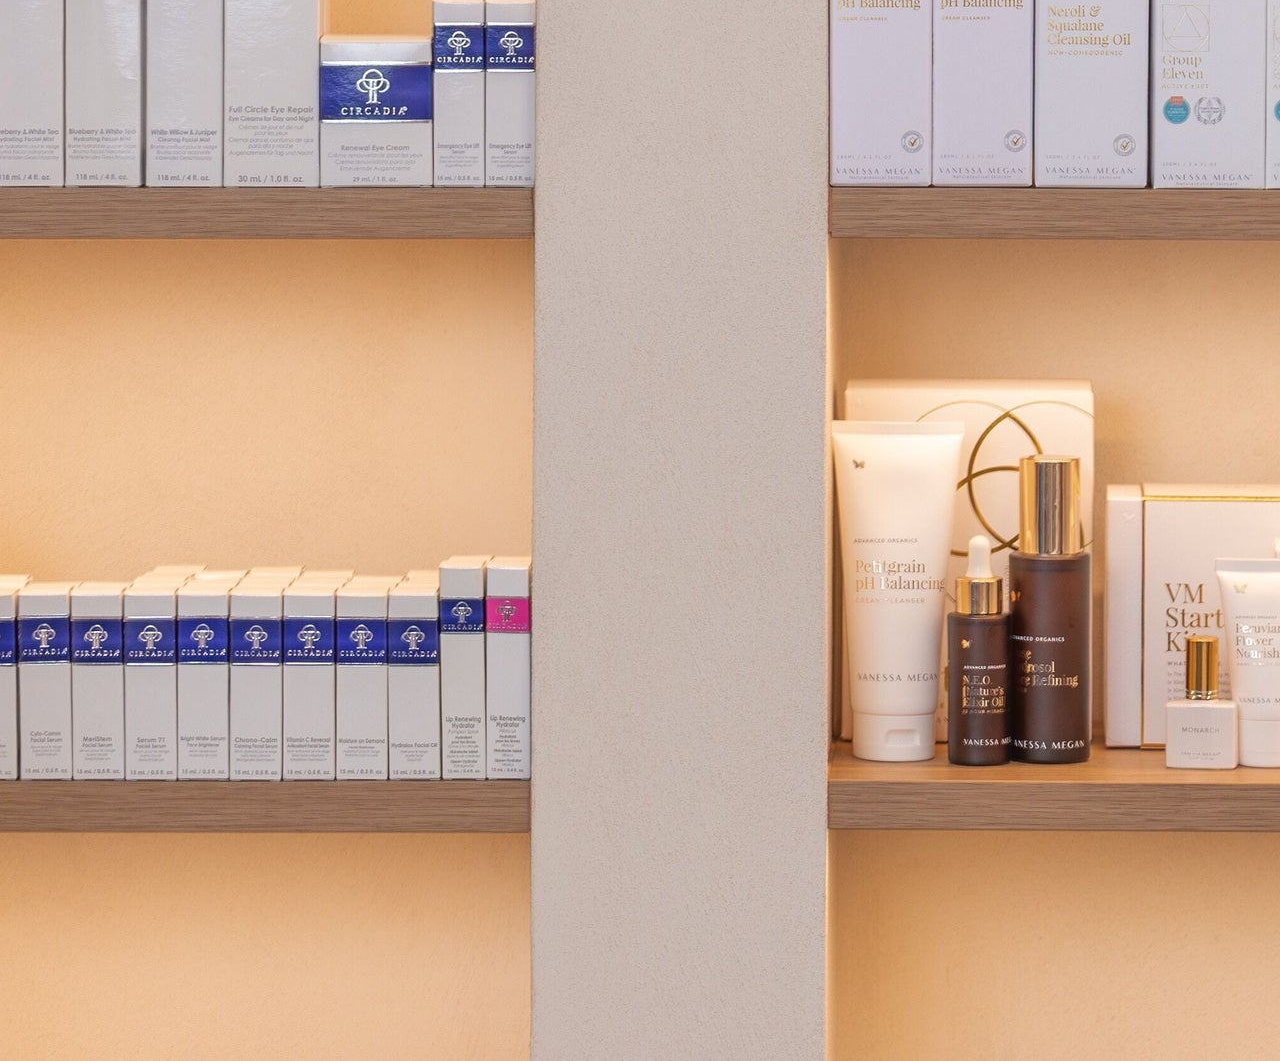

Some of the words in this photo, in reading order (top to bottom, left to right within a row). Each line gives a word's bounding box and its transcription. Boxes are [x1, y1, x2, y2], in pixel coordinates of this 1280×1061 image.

[1047, 4, 1086, 18] Neroli
[1089, 5, 1102, 17] &
[1047, 19, 1105, 34] Squalane
[1047, 33, 1109, 47] Cleansing
[1112, 33, 1131, 46] Oil
[1162, 54, 1202, 68] Group
[1162, 67, 1203, 80] Eleven
[228, 105, 244, 114] Full
[245, 105, 270, 114] Circle
[271, 106, 286, 115] Eye
[288, 105, 314, 115] Repair
[341, 144, 371, 152] Renewal
[371, 144, 386, 153] Eye
[855, 559, 926, 575] Petitgrain
[855, 576, 875, 592] pH
[880, 576, 946, 593] Balancing
[1165, 582, 1205, 604] VM
[1235, 635, 1274, 647] Flower
[858, 672, 902, 682] VANESSA
[906, 672, 939, 682] MEGAN
[962, 675, 992, 686] N.E.O.
[1032, 674, 1079, 688] Refining
[489, 715, 499, 723] Lip
[499, 715, 526, 724] Renewing
[495, 721, 520, 730] Hydrator
[1181, 726, 1220, 735] MONARCH
[963, 737, 999, 746] VANESSA
